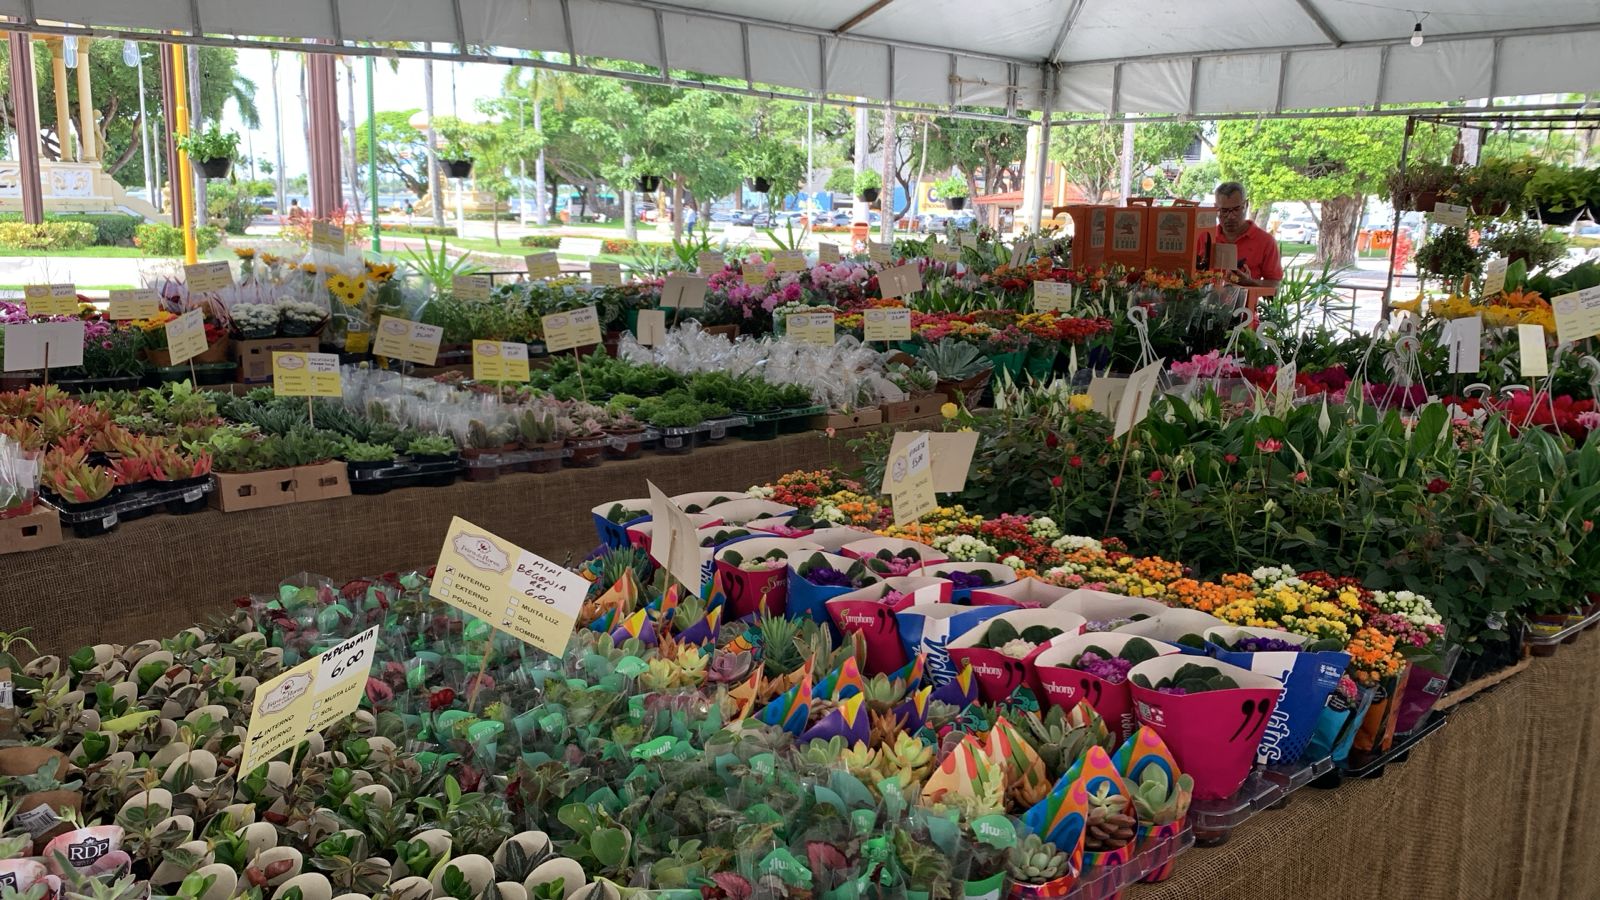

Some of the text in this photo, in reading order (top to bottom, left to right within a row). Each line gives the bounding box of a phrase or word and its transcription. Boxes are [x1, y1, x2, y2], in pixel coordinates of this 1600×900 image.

[516, 563, 568, 593] BEGONIA
[532, 560, 563, 577] MINI
[457, 572, 491, 592] INTERNO
[454, 583, 490, 603] EXTERNO
[525, 588, 556, 605] 6,00
[451, 594, 494, 618] POUCA LUZ
[521, 603, 560, 626] MUITA LUZ
[517, 614, 533, 626] SOL
[839, 608, 874, 630] Symphony
[514, 625, 546, 644] SOMBRA
[321, 629, 374, 665] PEPEROMIA
[331, 649, 364, 679] 6,00
[323, 682, 358, 704] MUITA LUZ
[316, 709, 344, 728] SOMBRA
[320, 706, 334, 716] SOL
[264, 714, 295, 735] INTERNO
[260, 726, 292, 748] EXTERNO
[257, 735, 296, 762] POUCA LUZ
[70, 842, 108, 861] RDP
